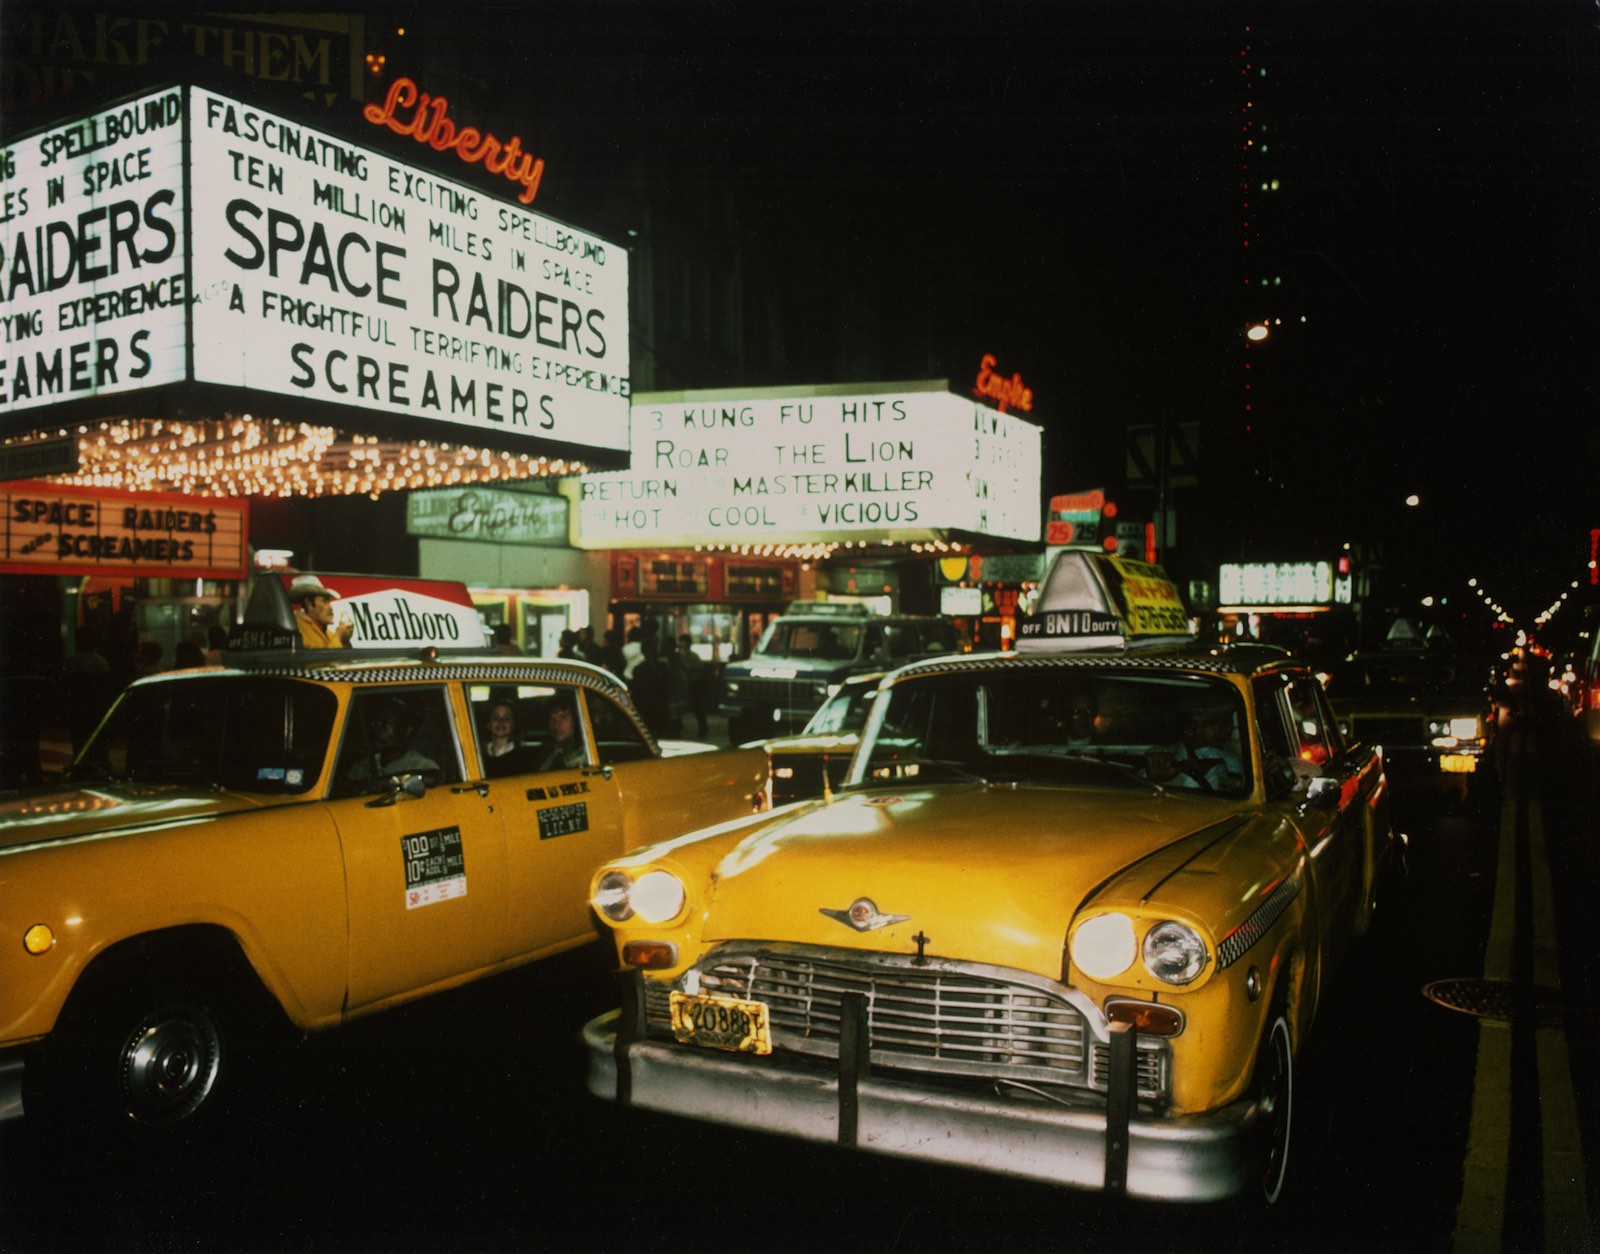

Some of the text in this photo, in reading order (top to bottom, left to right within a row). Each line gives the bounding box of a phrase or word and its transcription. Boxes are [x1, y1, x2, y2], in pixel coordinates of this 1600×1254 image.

[181, 23, 332, 86] THEM
[40, 93, 181, 168] SPELLBOUND
[364, 77, 546, 204] Liberty
[47, 175, 64, 208] IN
[83, 148, 151, 196] SPACE
[207, 97, 607, 266] FASCINATING EXCITING SPELLBOUND
[0, 189, 176, 302] AIDERS
[227, 150, 593, 295] TEN MILLION MILES IN SPACE
[0, 274, 185, 343] YING EXPERIENCE
[223, 198, 607, 359] SPACE RAIDERS
[228, 283, 246, 315] A
[262, 291, 397, 347] FRIGHTFUL
[409, 326, 523, 375] TERRIFYING
[532, 357, 630, 398] EXPERIENCE
[289, 343, 556, 430] SCREAMERS
[650, 400, 908, 431] 3 KUNG FU HITS
[655, 432, 915, 470] ROAR THE LION
[13, 499, 217, 534] SPACE RAIDERS
[582, 479, 678, 502] RETURN
[615, 508, 663, 530] HOT
[708, 506, 777, 527] COOL
[817, 500, 919, 525] VICIOUS
[57, 533, 195, 561] SCREAMERS
[349, 597, 459, 641] Marlboro
[1022, 612, 1118, 635] OFF 8N10 DUTY
